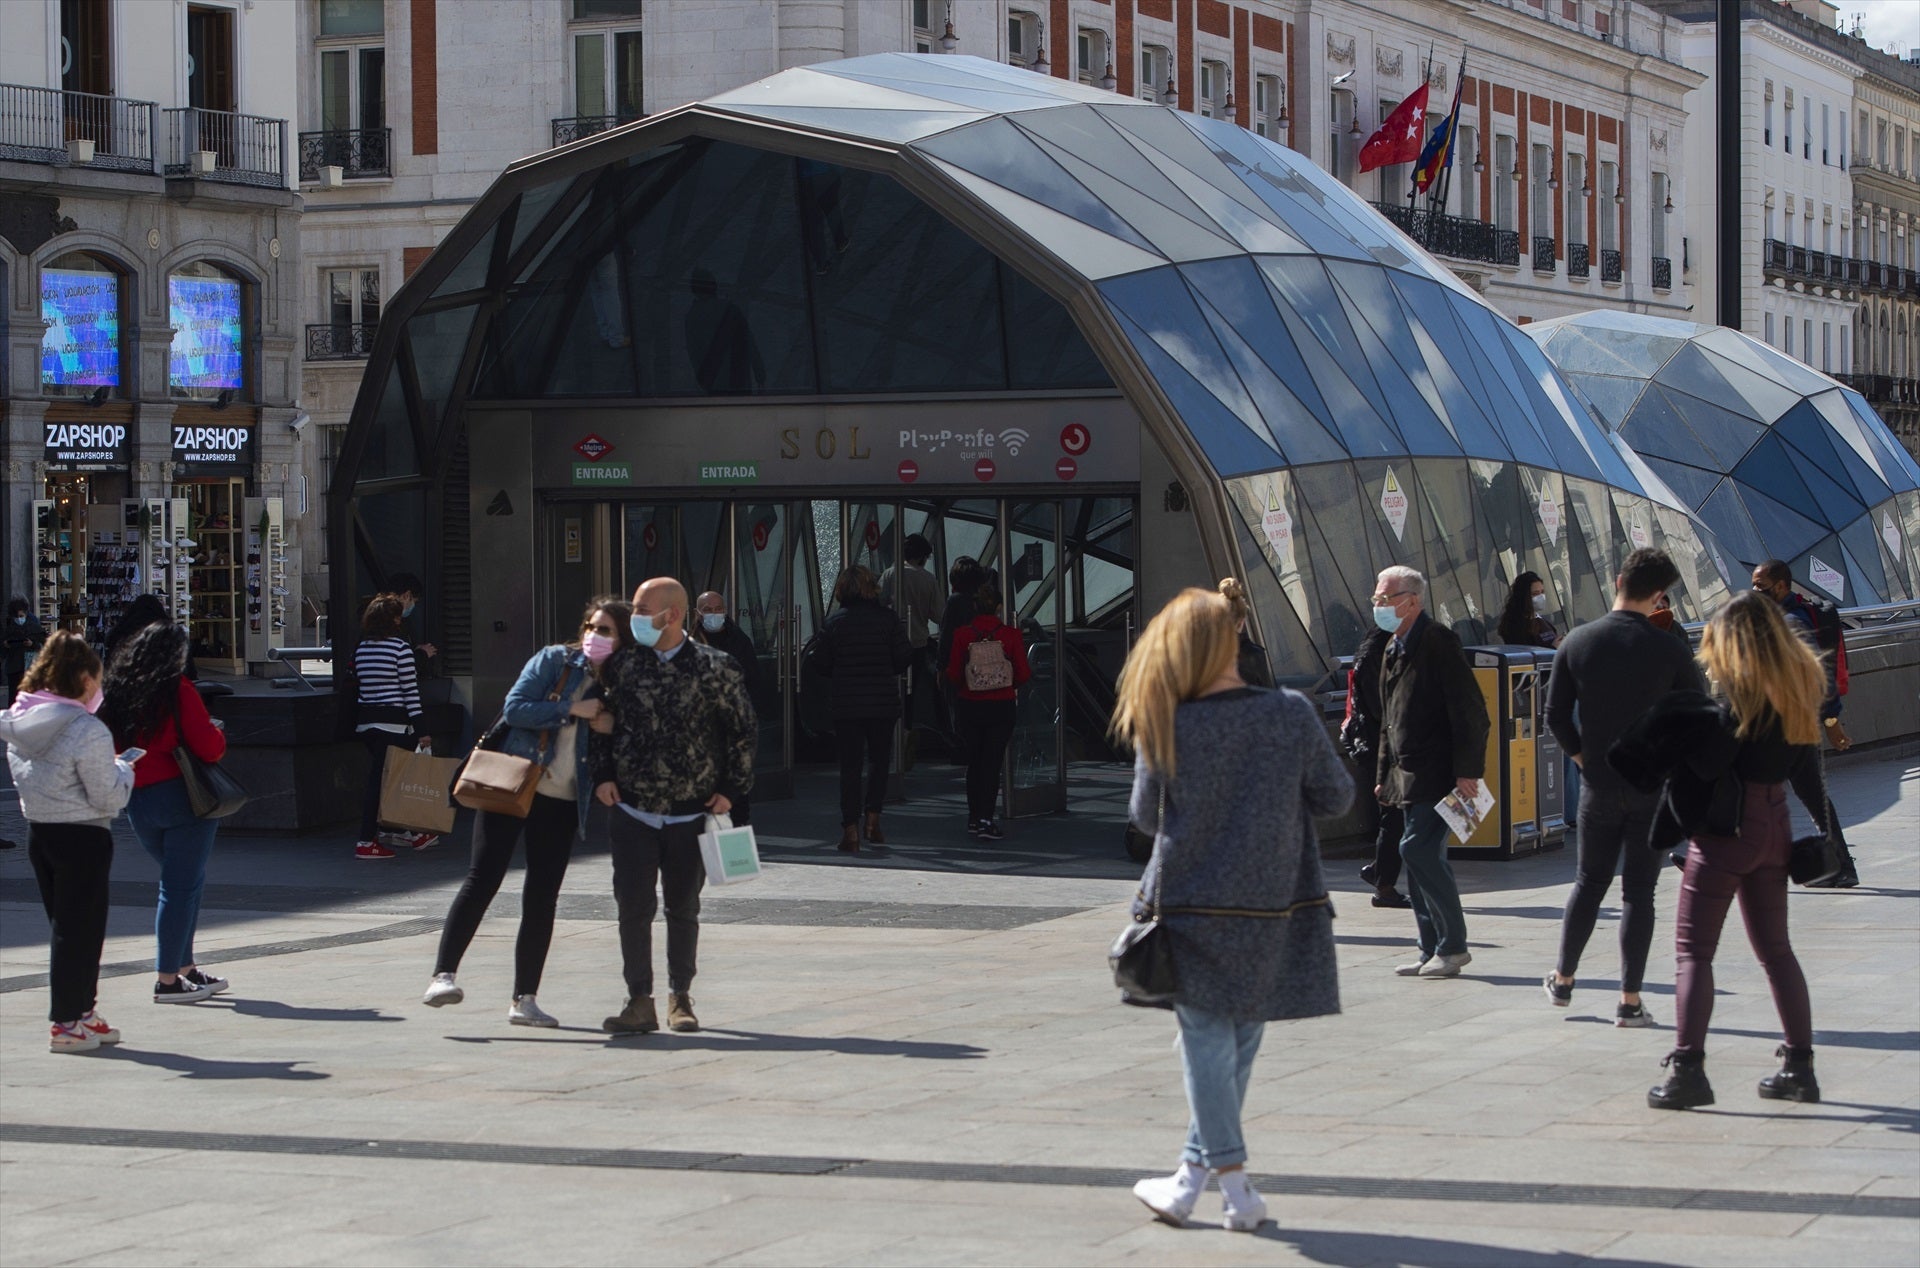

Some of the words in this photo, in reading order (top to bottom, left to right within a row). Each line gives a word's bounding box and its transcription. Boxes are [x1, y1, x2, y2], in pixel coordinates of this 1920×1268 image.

[47, 424, 126, 448] ZAPSHOP
[174, 427, 249, 450] ZAPSHOP
[583, 443, 603, 451] Metro
[58, 451, 114, 460] WWW.ZAPSHOP.ES
[184, 453, 236, 462] WWW.ZAPSHOP.ES
[576, 467, 629, 479] ENTRADA
[701, 466, 757, 478] ENTRADA
[1384, 495, 1405, 508] PELIGRO
